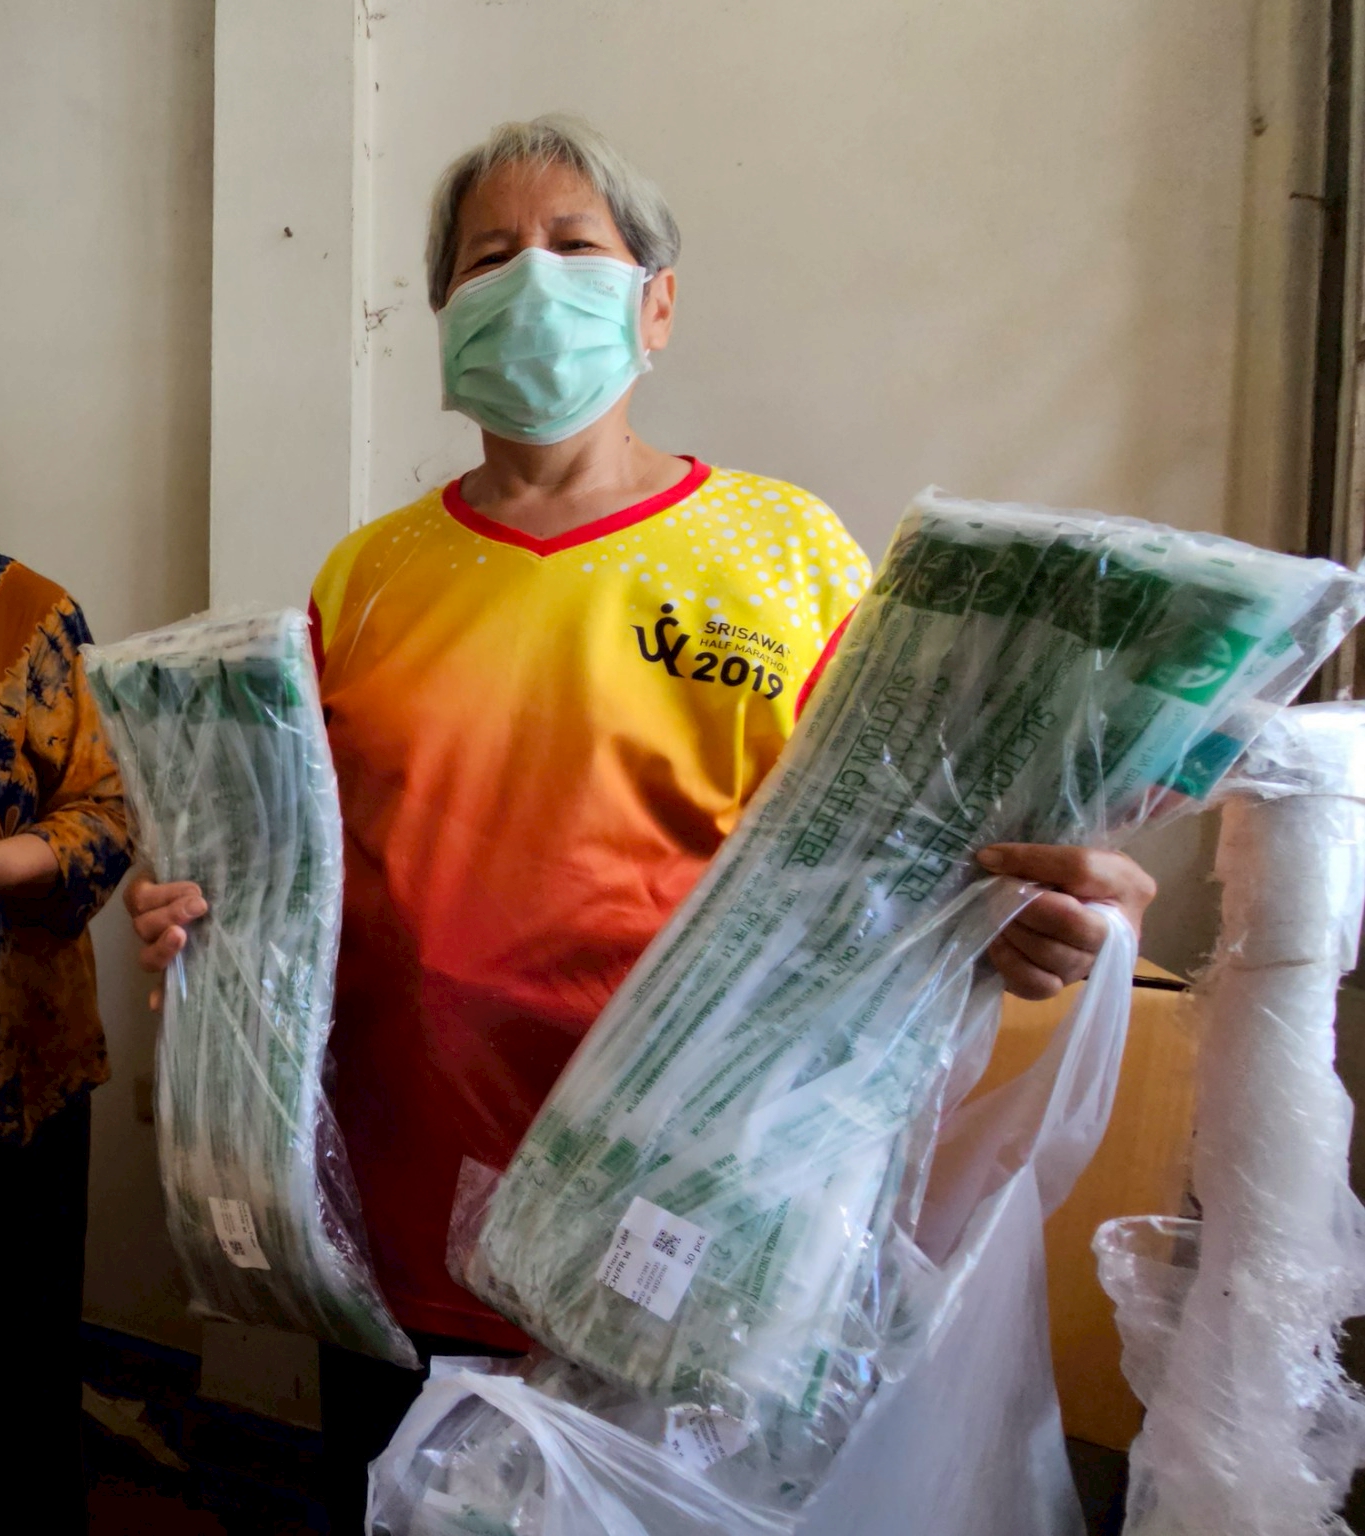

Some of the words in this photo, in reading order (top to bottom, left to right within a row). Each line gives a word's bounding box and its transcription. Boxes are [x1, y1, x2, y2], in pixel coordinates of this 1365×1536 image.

[699, 638, 732, 650] HALF
[734, 643, 789, 676] MARATHON
[691, 652, 784, 701] 2019
[850, 668, 919, 771] SUCTION
[972, 703, 1060, 808] SUCTION
[790, 765, 869, 874] CATHETER
[778, 886, 802, 912] TYPE
[731, 910, 762, 946] CH/FR
[719, 943, 738, 961] 14
[726, 941, 766, 985] STANDARD
[826, 943, 861, 979] CH/FR
[811, 973, 831, 991] 14
[615, 1228, 631, 1252] Tube
[682, 1251, 698, 1268] 50
[691, 1233, 707, 1254] pcs
